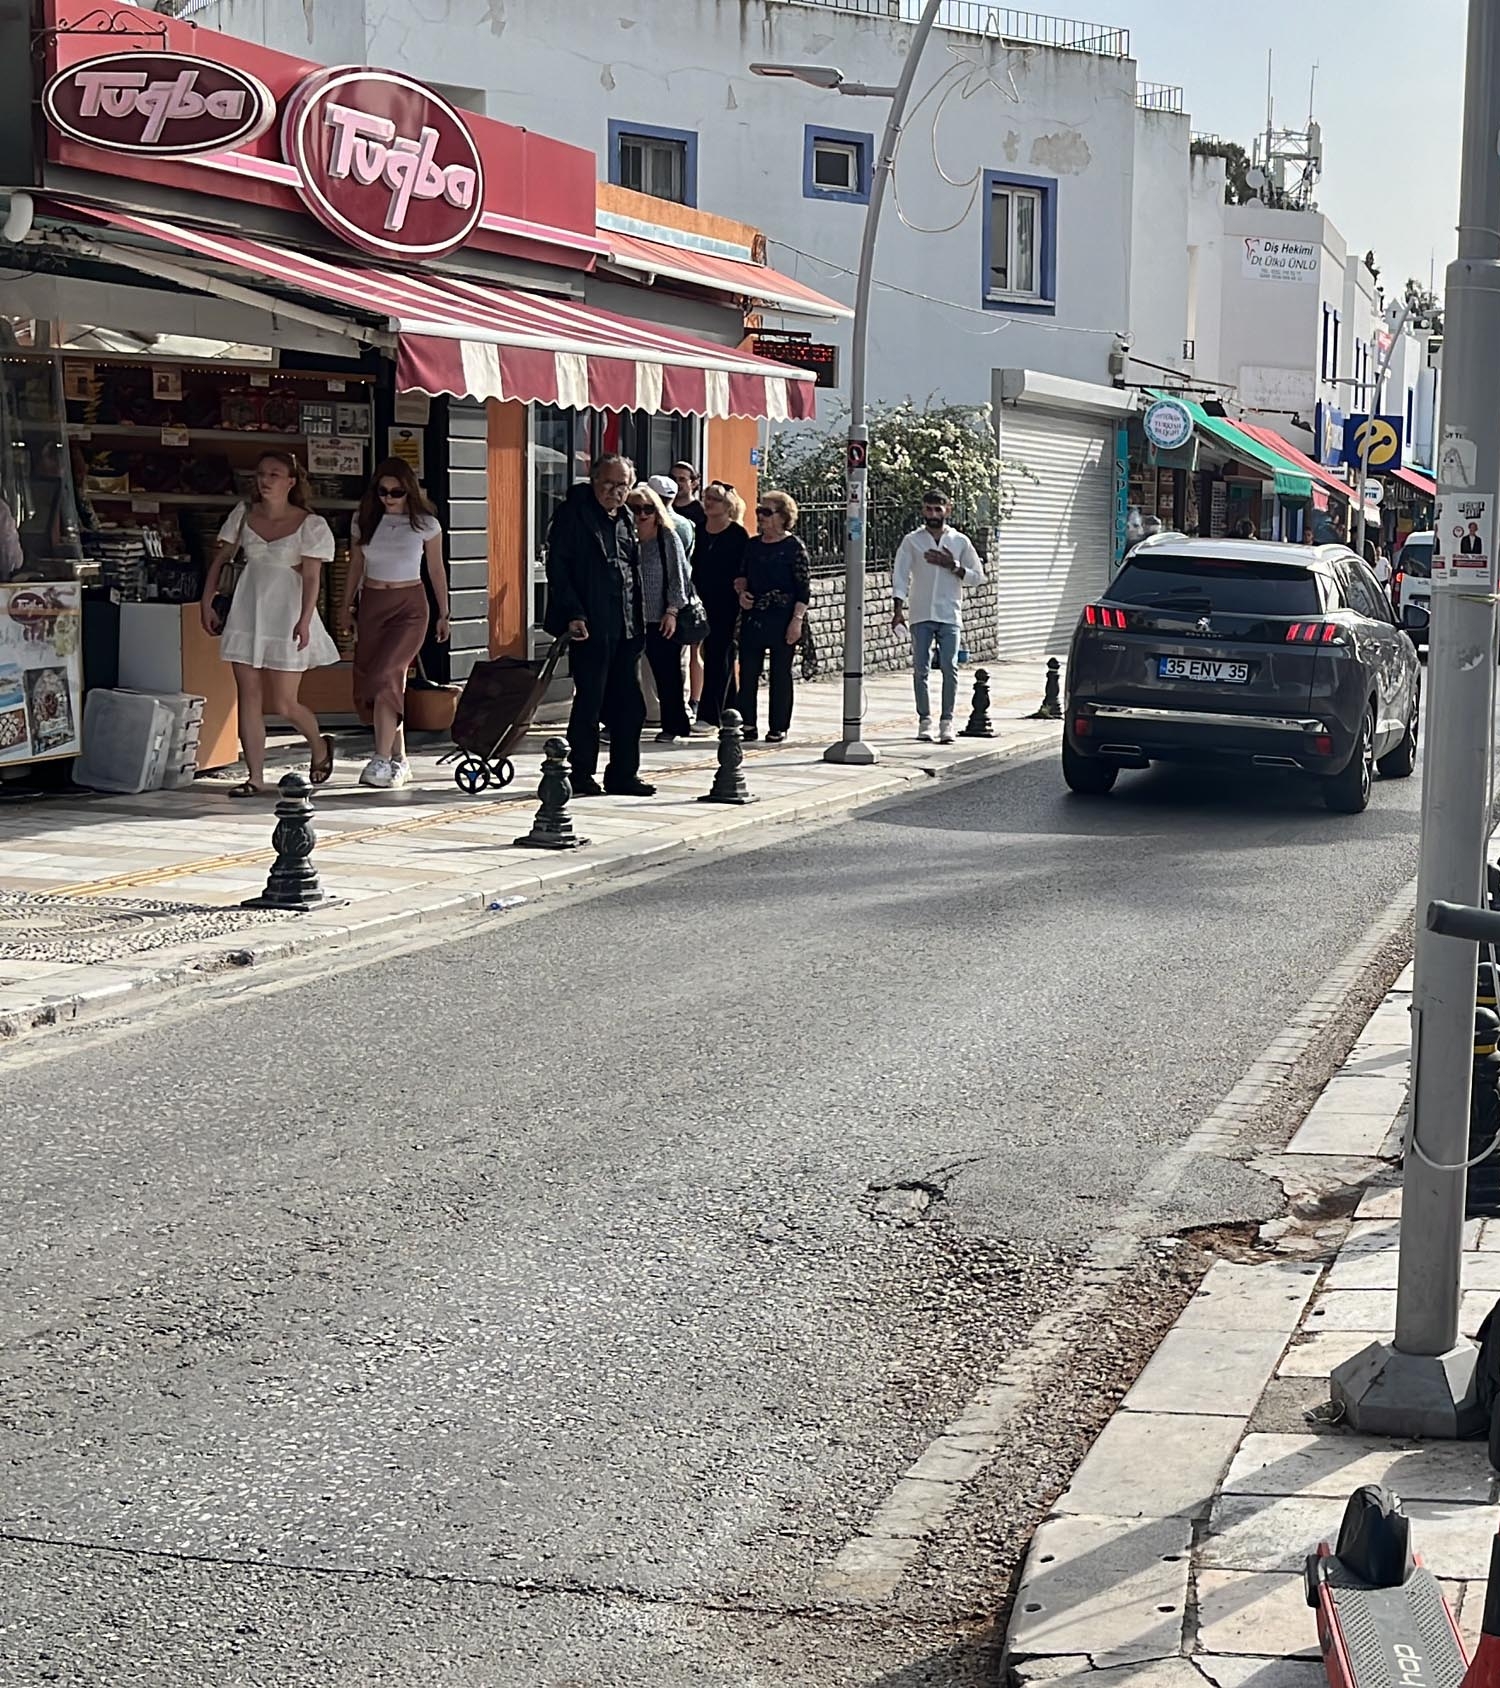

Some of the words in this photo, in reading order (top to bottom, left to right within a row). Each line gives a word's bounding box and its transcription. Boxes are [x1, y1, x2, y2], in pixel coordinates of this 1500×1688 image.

[1264, 241, 1279, 255] Diş
[1281, 243, 1314, 256] Hekimi
[1167, 658, 1186, 674] 35
[1190, 660, 1222, 676] ENV
[1228, 664, 1247, 679] 35
[1393, 1643, 1428, 1687] hop
